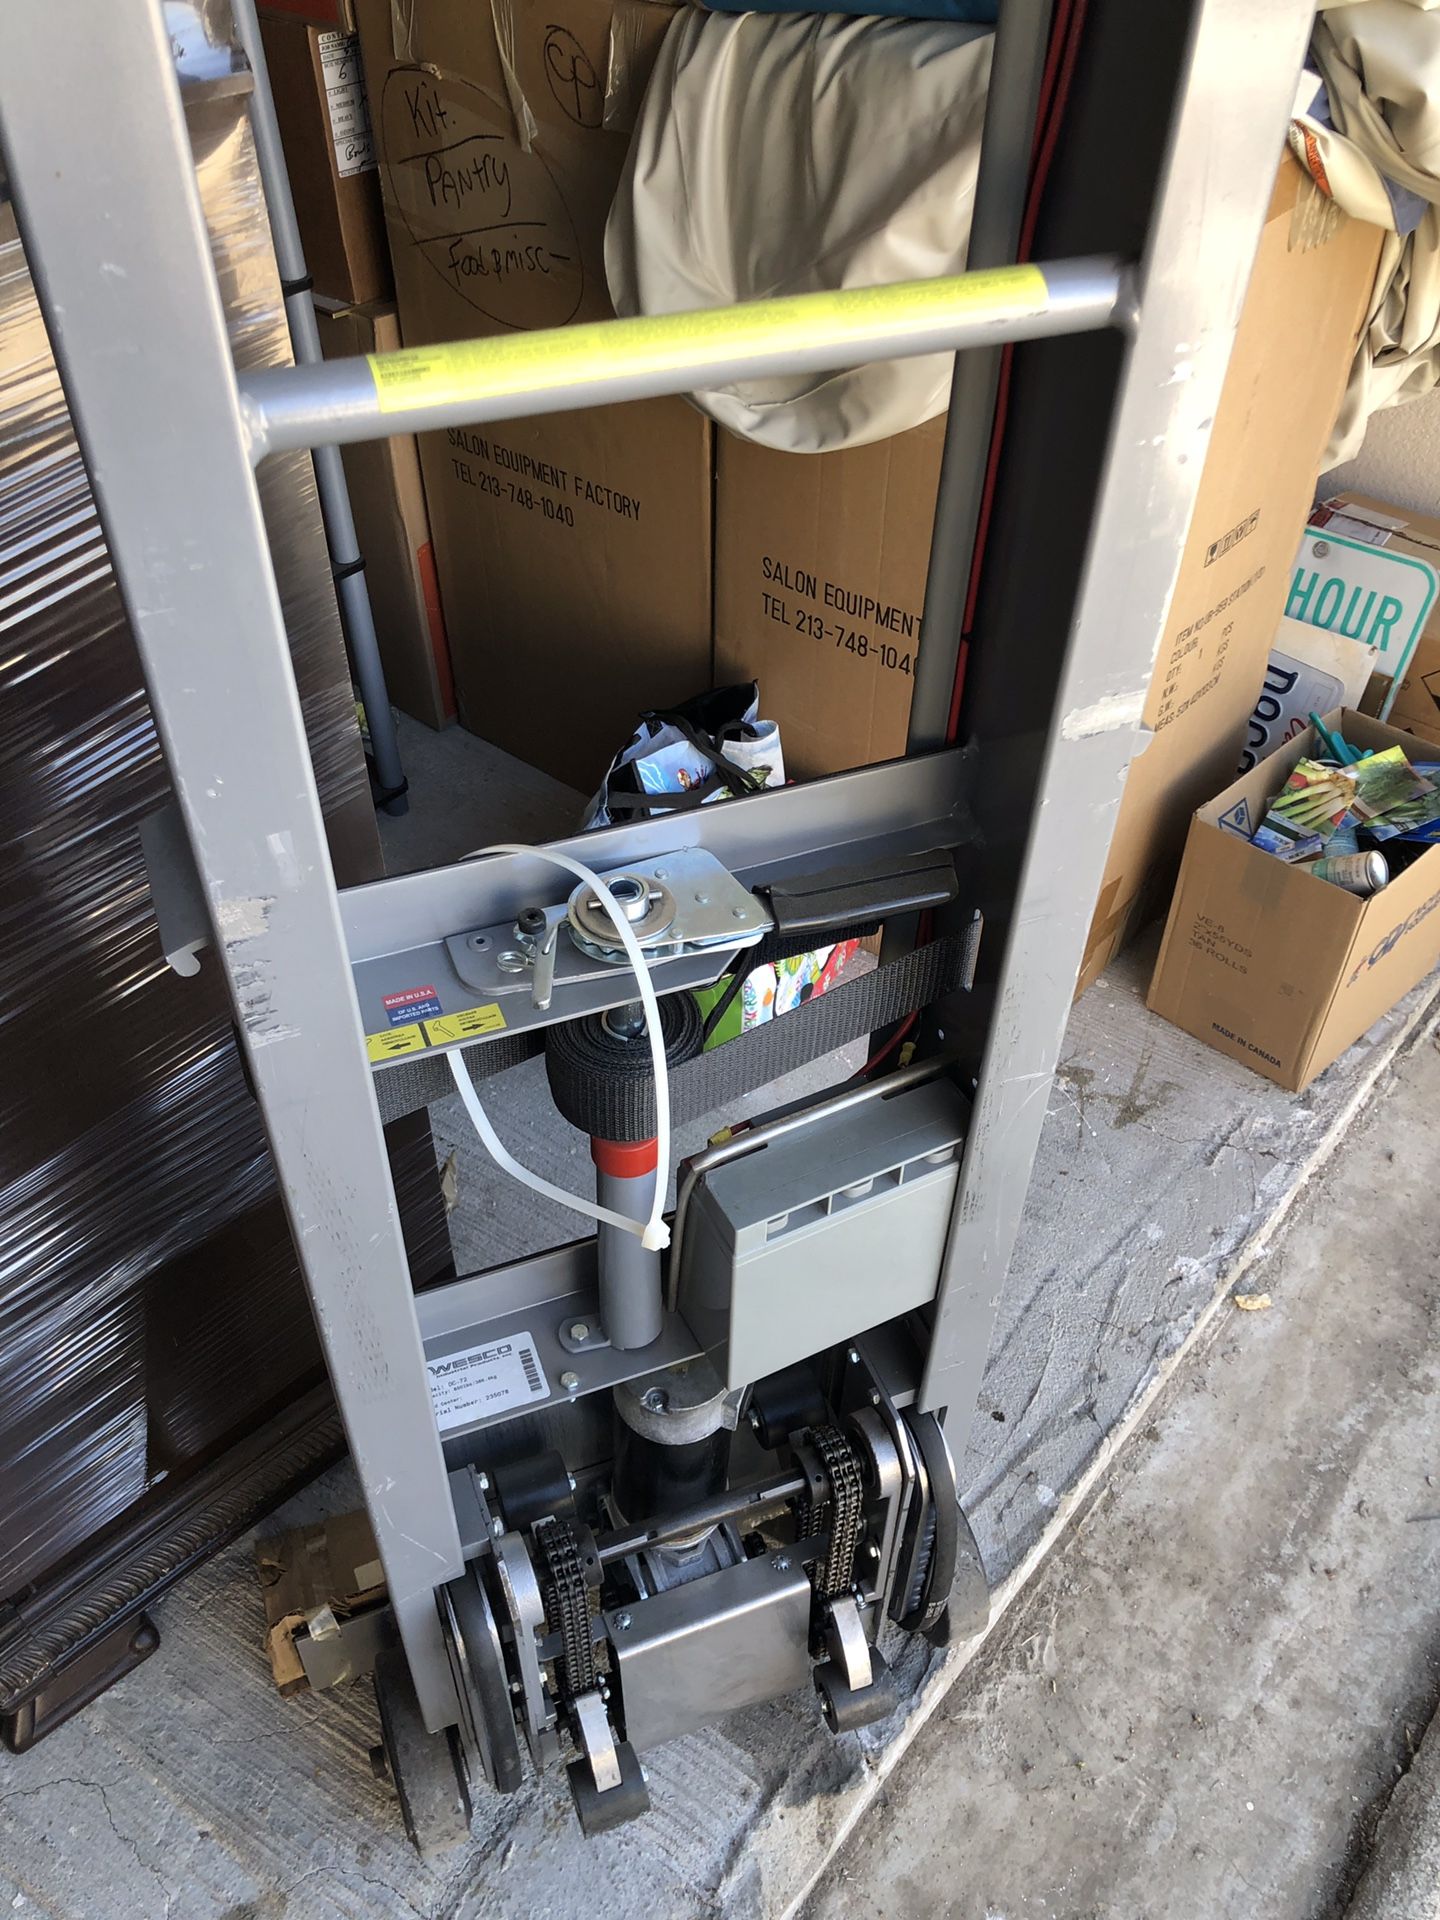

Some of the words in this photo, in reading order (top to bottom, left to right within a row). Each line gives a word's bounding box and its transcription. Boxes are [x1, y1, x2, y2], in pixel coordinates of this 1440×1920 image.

[447, 427, 490, 462] SALON
[493, 444, 568, 492] EQUIPMENT
[574, 476, 641, 521] FACTORY
[452, 458, 477, 487] TEL
[478, 471, 575, 528] 213-748-1040
[762, 556, 818, 600] SALON
[761, 592, 791, 626] TEL
[1284, 567, 1403, 652] HOUR
[1206, 948, 1248, 975] ROLLS
[385, 995, 405, 1006] MADE
[391, 1010, 421, 1022] IMPORTED
[1212, 1022, 1236, 1040] MADE
[1236, 1036, 1247, 1048] IN
[1247, 1043, 1281, 1069] CANADA
[427, 1344, 512, 1376] WESCO
[435, 1407, 452, 1417] rial
